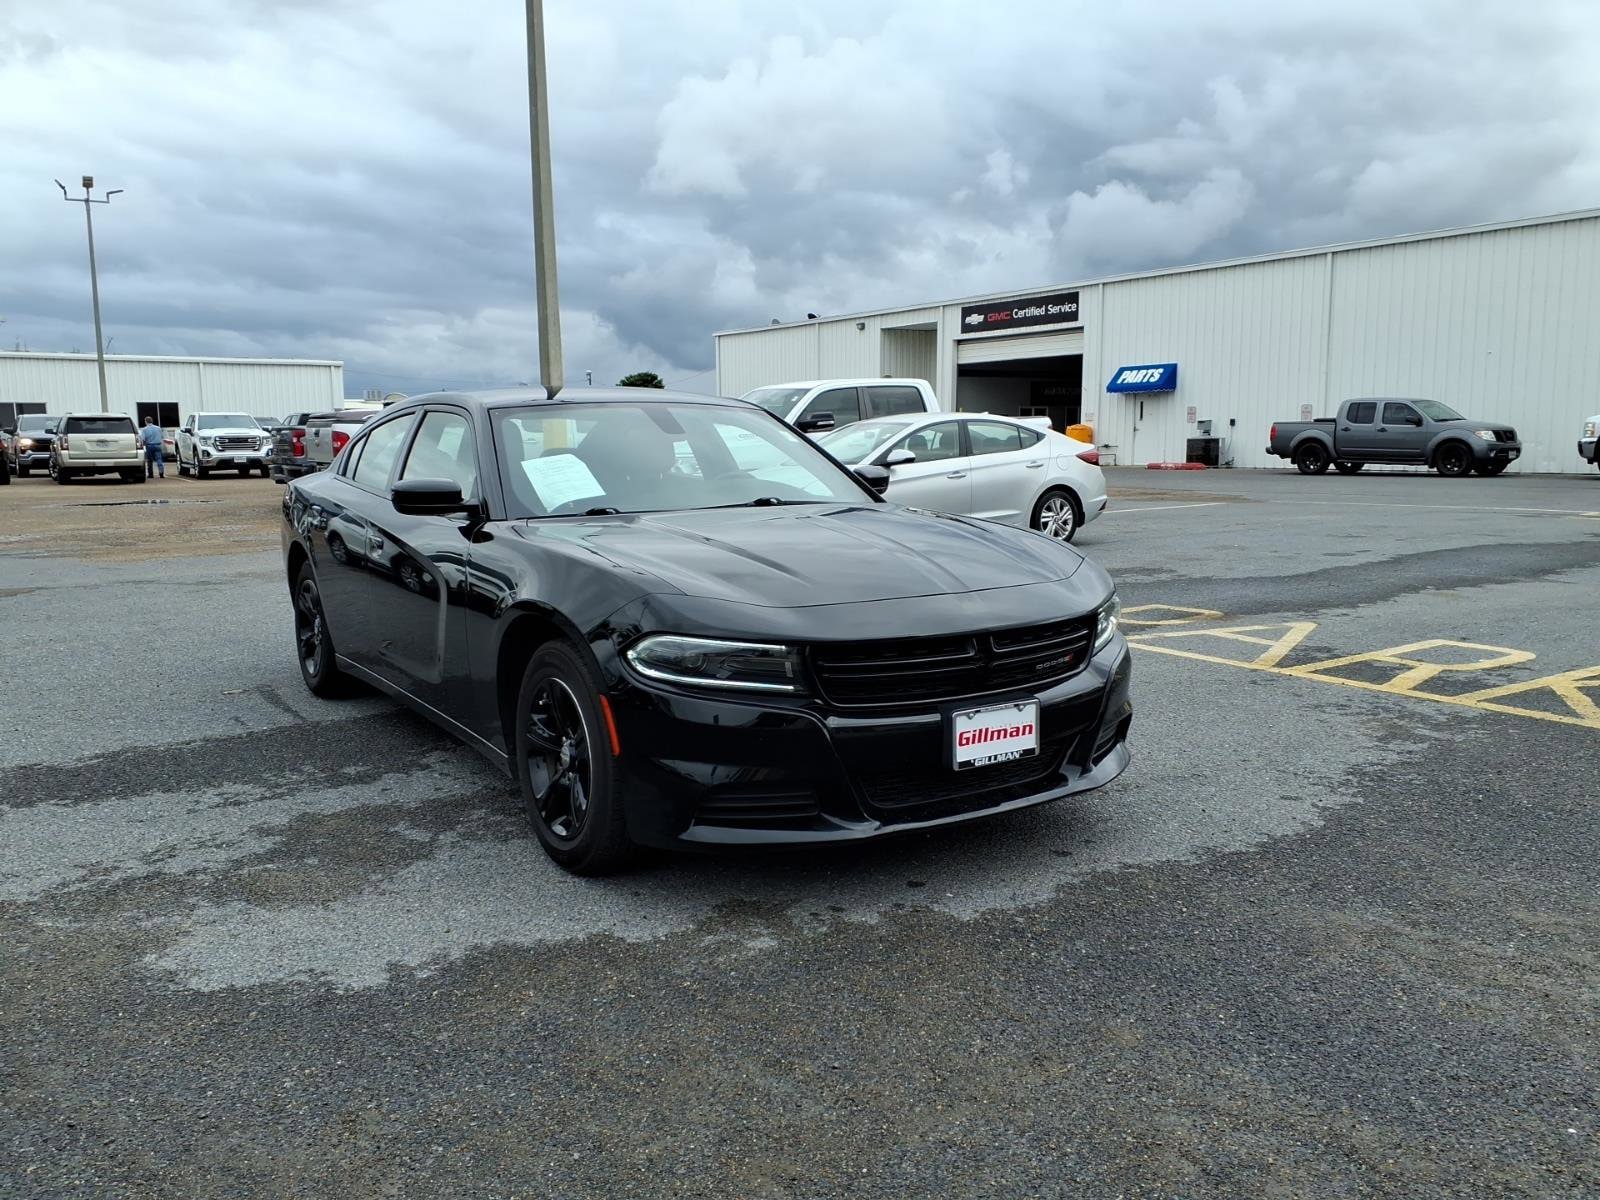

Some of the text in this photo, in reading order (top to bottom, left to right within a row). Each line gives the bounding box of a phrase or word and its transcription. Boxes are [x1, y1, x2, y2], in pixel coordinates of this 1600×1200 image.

[987, 302, 1077, 322] GMC Certified Service
[1117, 368, 1164, 384] PARTS
[958, 723, 1034, 747] Gillman
[973, 750, 1021, 767] GILLMAN
